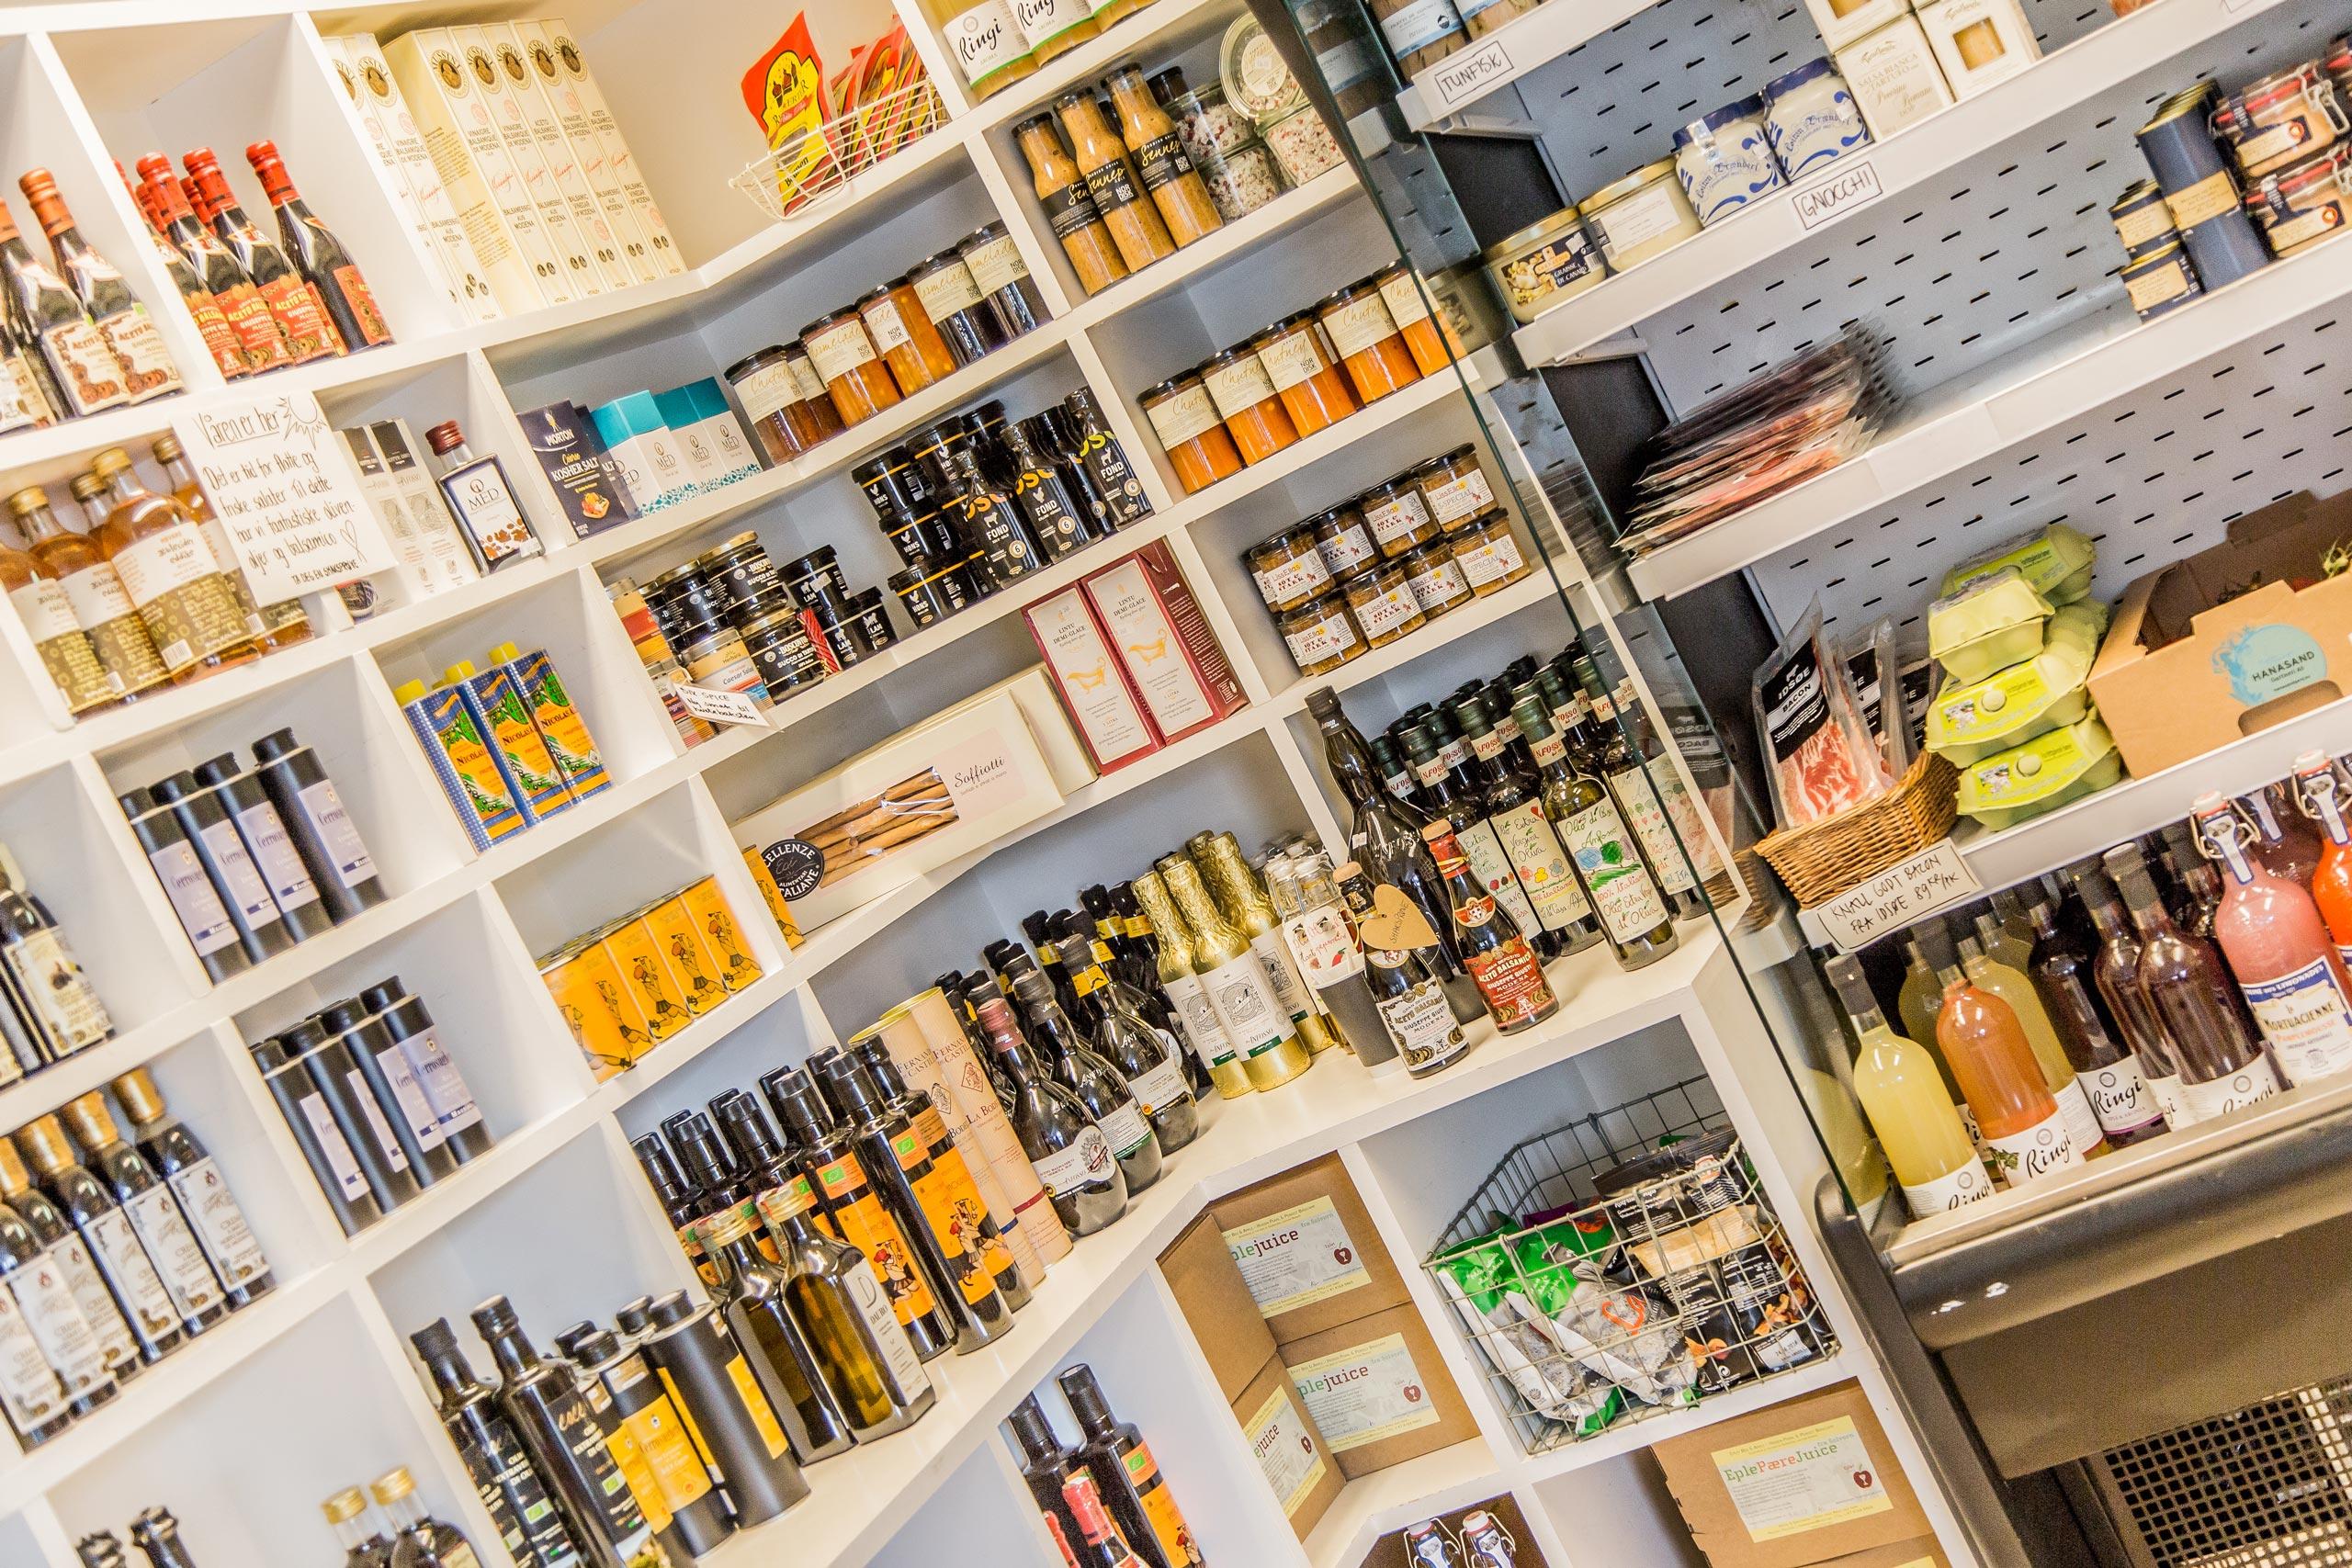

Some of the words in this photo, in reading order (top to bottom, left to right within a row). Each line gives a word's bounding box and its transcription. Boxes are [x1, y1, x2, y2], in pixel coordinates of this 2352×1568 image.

[958, 17, 1004, 64] Ringi
[1441, 52, 1502, 92] TUNFISK
[1140, 137, 1183, 166] Sennep
[1175, 156, 1187, 166] NOR
[1085, 165, 1126, 197] Sennep
[1115, 184, 1130, 194] NOR
[1118, 190, 1134, 201] DISK
[1800, 172, 1872, 218] GNOCCHI
[1009, 259, 1023, 269] NOR
[1012, 264, 1026, 275] DISK
[888, 326, 900, 337] NOR
[889, 331, 904, 342] DISK
[856, 344, 869, 354] NOR
[858, 348, 873, 358] DISK
[1300, 356, 1315, 367] NOR
[1303, 362, 1317, 374] DISK
[254, 405, 279, 434] her
[545, 428, 575, 446] MORTON
[720, 434, 741, 451] MED
[653, 453, 677, 471] MED
[689, 445, 710, 461] MED
[202, 465, 227, 490] Det
[230, 471, 240, 483] er
[243, 462, 257, 479] tid
[257, 457, 271, 479] for
[301, 451, 319, 473] og
[550, 460, 579, 482] KOSHER
[577, 457, 600, 473] SALT
[1101, 461, 1125, 479] FOND
[219, 496, 248, 519] friske
[254, 489, 287, 508] salater
[308, 477, 332, 494] dette
[467, 487, 500, 509] MED
[1035, 500, 1057, 516] FOND
[232, 525, 253, 545] har
[255, 520, 265, 538] vi
[266, 507, 321, 536] fantastiske
[987, 524, 1010, 540] FOND
[1063, 520, 1070, 530] 6
[273, 546, 291, 570] og
[286, 532, 337, 555] balsamico
[1013, 544, 1023, 555] 6
[300, 570, 314, 583] DEG
[747, 573, 767, 586] SUCCO
[803, 591, 817, 603] LAM
[1117, 594, 1136, 606] LINTU
[1113, 597, 1146, 616] DEMI-GLACE
[869, 623, 883, 635] LAM
[1053, 626, 1086, 644] DEMI-GLACE
[1058, 622, 1075, 635] LINTU
[836, 639, 852, 651] LAM
[777, 656, 797, 669] SUCCO
[2252, 650, 2315, 682] HANASAND
[723, 672, 741, 686] Caesar
[1777, 666, 1812, 701] IDSØE
[1781, 683, 1812, 713] BACON
[707, 702, 732, 713] smak
[541, 711, 569, 728] NICOLAS
[502, 729, 529, 746] NICOLAS
[1514, 816, 1540, 829] Extra
[1565, 815, 1587, 837] Olio
[1463, 833, 1488, 848] Extra
[1904, 853, 1942, 880] BACON
[779, 870, 808, 888] ALIMENTARI
[1850, 917, 1875, 935] FRA
[1478, 970, 1498, 983] ACETO
[1498, 952, 1532, 974] BALSAMICO
[2277, 964, 2324, 989] LIMONADES
[1487, 974, 1514, 989] GIUSEPPE
[1516, 965, 1532, 977] GIUSTI
[1497, 975, 1529, 992] MODENA
[1395, 1010, 1415, 1023] ACETO
[1415, 995, 1444, 1015] BALSAMICO
[2264, 1002, 2334, 1032] MORTUACIENNE
[1404, 1011, 1432, 1031] GIUSEPPE
[1433, 1006, 1446, 1017] GIUSTI
[1413, 1015, 1444, 1032] MODENA
[2093, 1075, 2143, 1117] Ringi
[2027, 1128, 2073, 1180] Ringi
[1231, 1229, 1299, 1261] plejuice
[854, 1269, 877, 1310] D
[869, 1304, 889, 1325] DAURO
[1297, 1365, 1369, 1399] plejuice
[1253, 1423, 1280, 1459] ejuice
[1723, 1444, 1838, 1483] EplePæreJuice
